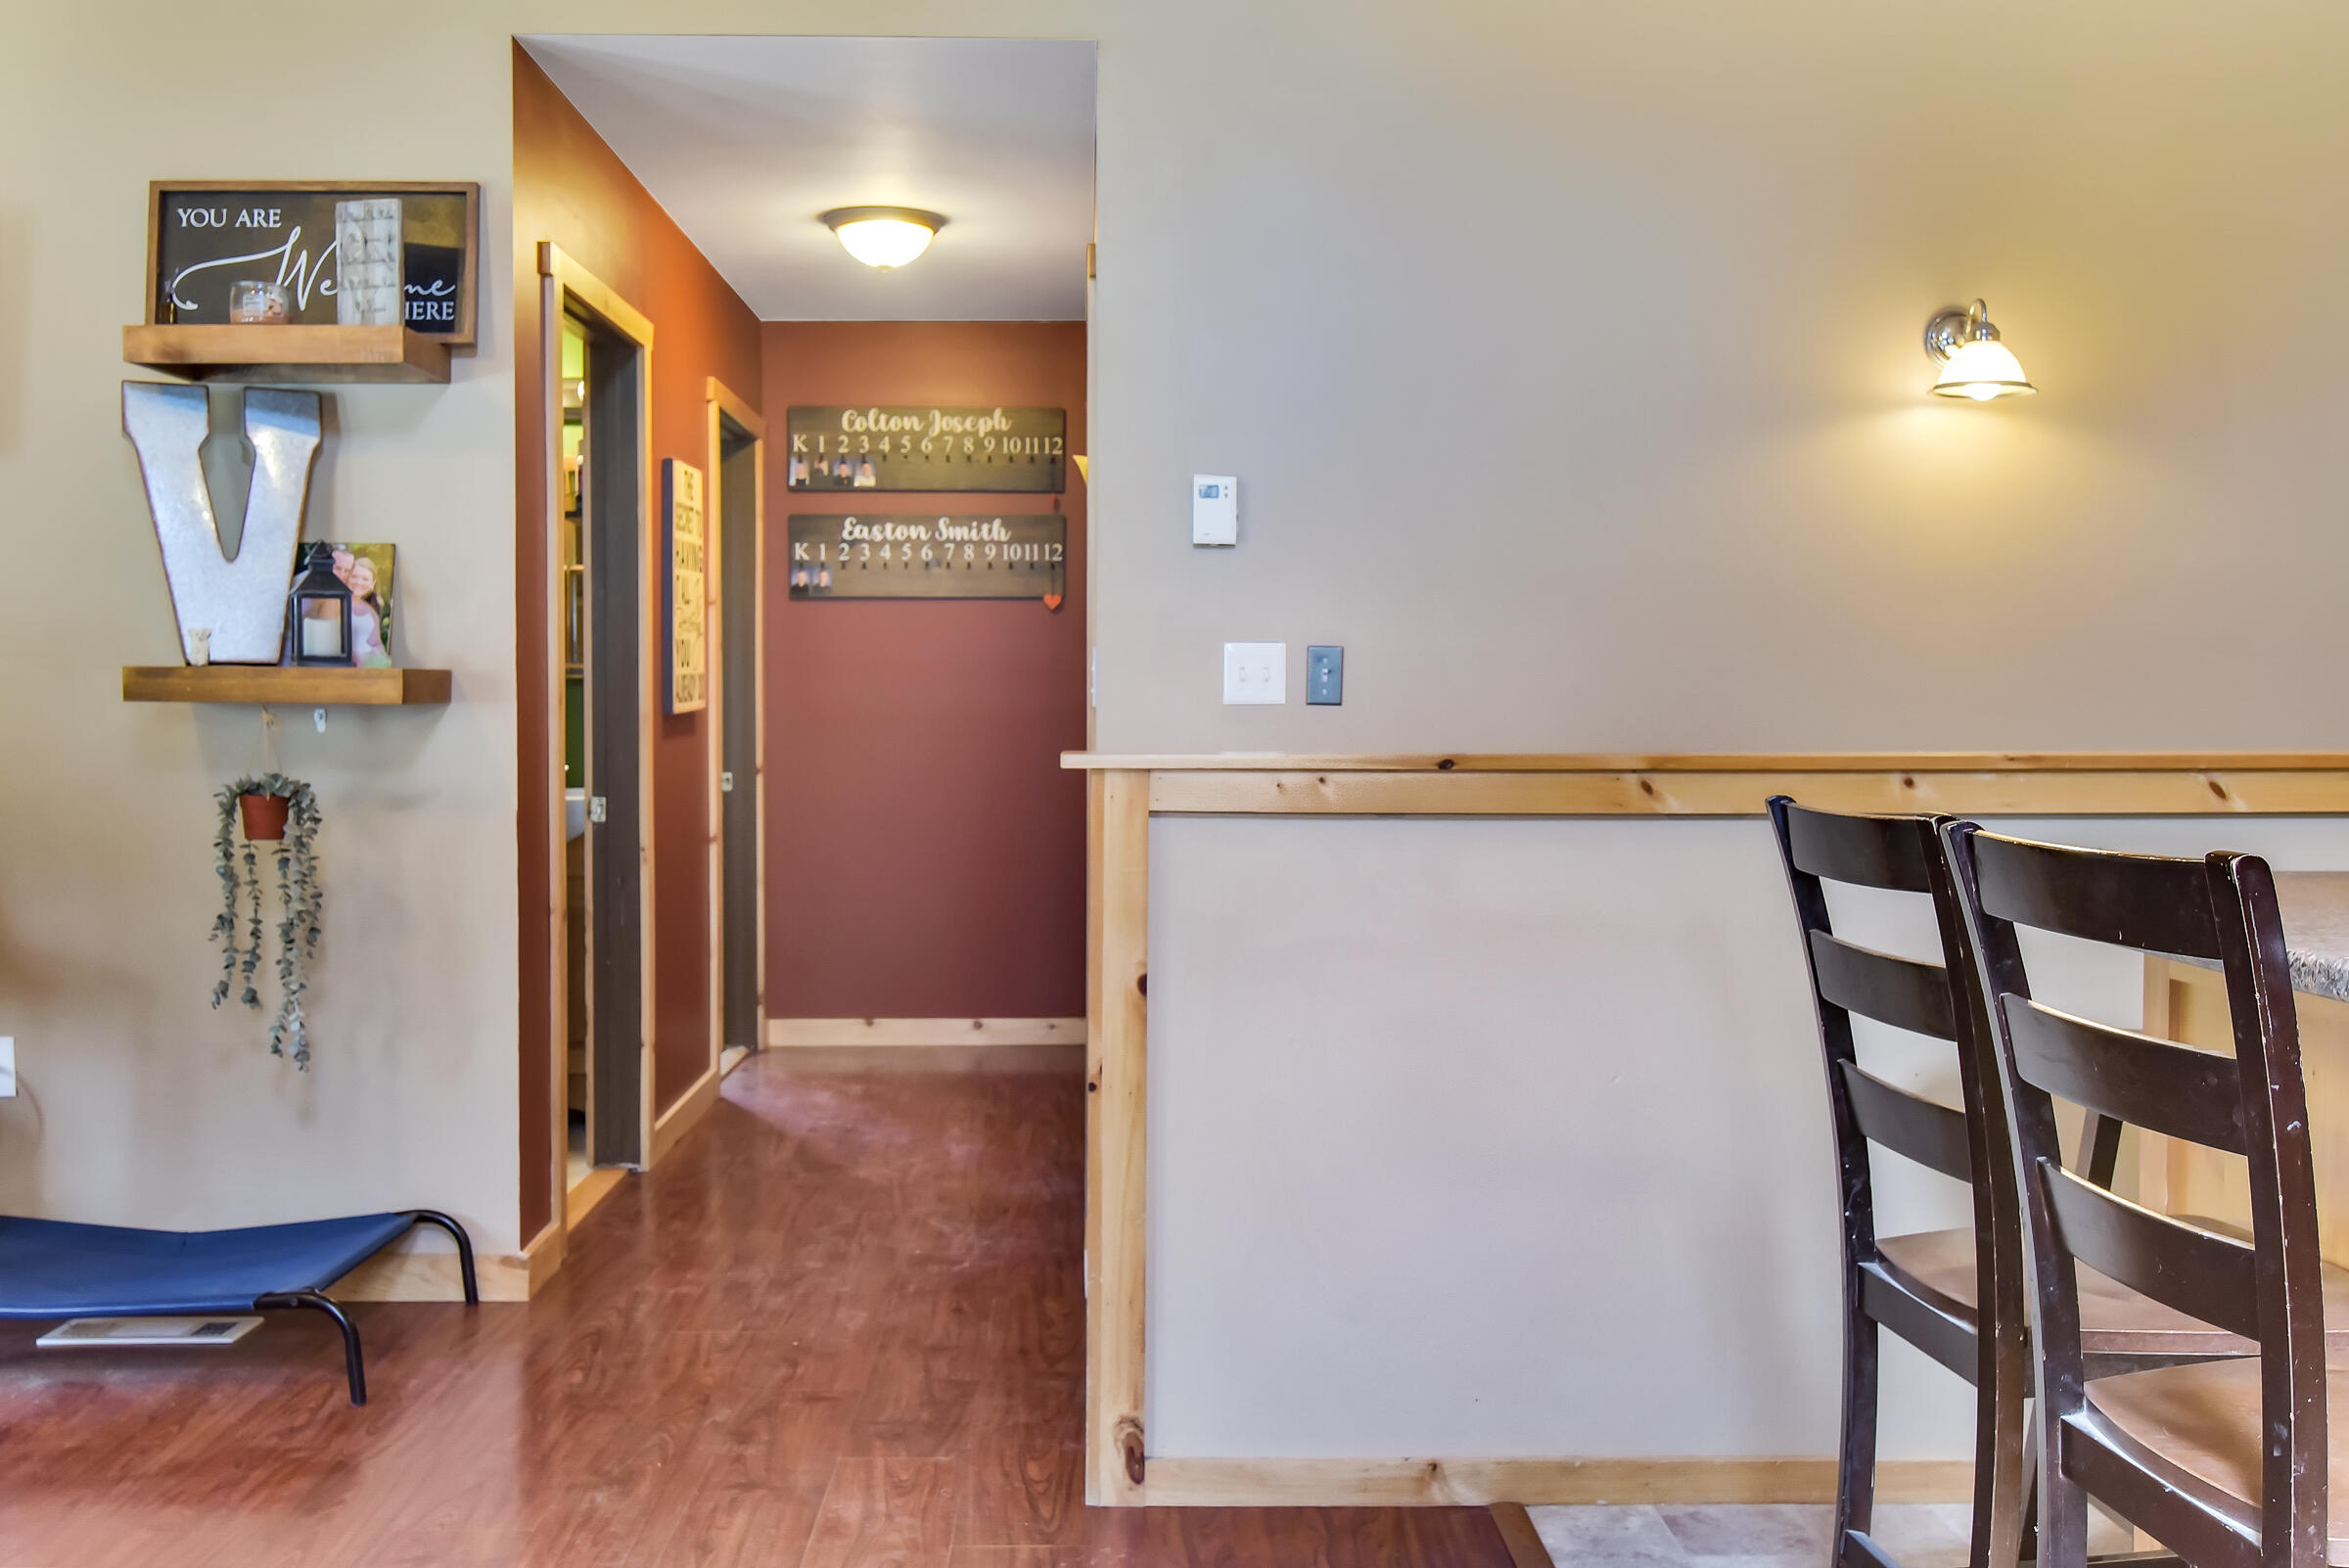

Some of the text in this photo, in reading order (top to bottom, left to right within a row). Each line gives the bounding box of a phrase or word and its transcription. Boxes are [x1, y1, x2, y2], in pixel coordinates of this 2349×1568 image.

[176, 208, 282, 228] YOU ARE
[842, 407, 1012, 438] Colton Joseph
[793, 435, 1063, 454] K 1 2 3 4 5 6 7 8 9 10 11 12
[121, 380, 322, 667] V
[842, 516, 1012, 542] Easton Smith
[794, 542, 1063, 562] K 1 2 3 4 5 6 7 8 9 10 11 12
